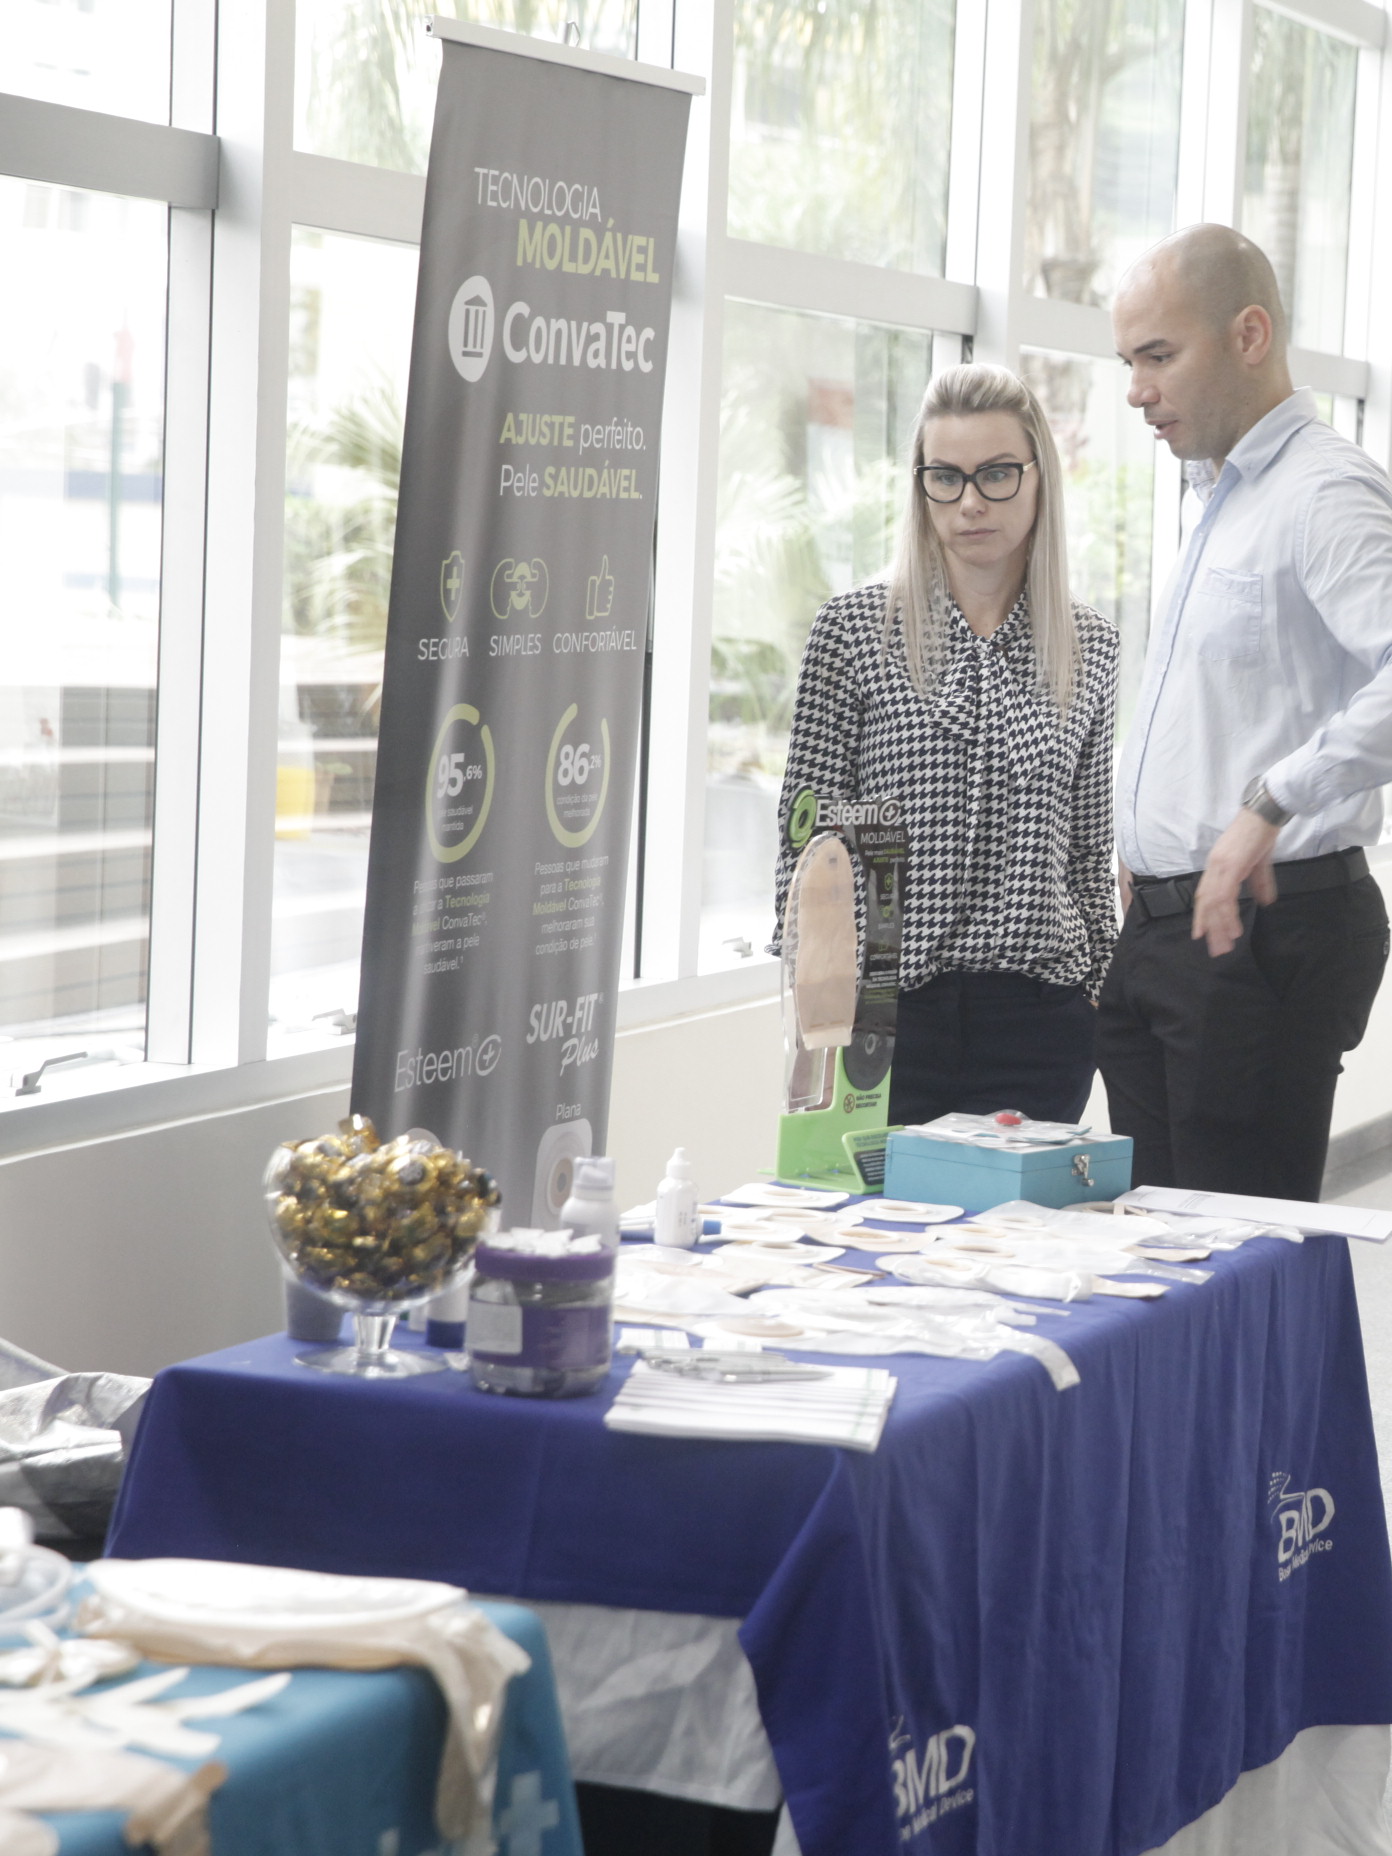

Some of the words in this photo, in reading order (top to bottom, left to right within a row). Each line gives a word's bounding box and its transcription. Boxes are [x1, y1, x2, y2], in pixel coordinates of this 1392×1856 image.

[474, 167, 601, 222] TECNOLOGIA
[516, 218, 659, 283] MOLDÁVEL
[503, 301, 655, 373] ConvaTec
[499, 412, 575, 447] AJUSTE
[579, 417, 646, 455] perfeito.
[500, 464, 538, 497] Pele
[543, 460, 643, 500] SAUDÁVEL.
[418, 637, 469, 660] SEGURA
[490, 634, 542, 657] SIMPLES
[553, 626, 637, 654] CONFORTÁVEL
[860, 829, 906, 844] MOLDÁVEL
[534, 862, 565, 876] Pessoas
[566, 861, 580, 874] que
[439, 877, 454, 891] que
[456, 872, 494, 890] passaram
[540, 883, 556, 898] para
[446, 893, 490, 908] Tecnologia
[464, 933, 480, 951] pele
[560, 1035, 599, 1077] Plus
[556, 1102, 582, 1121] Plana
